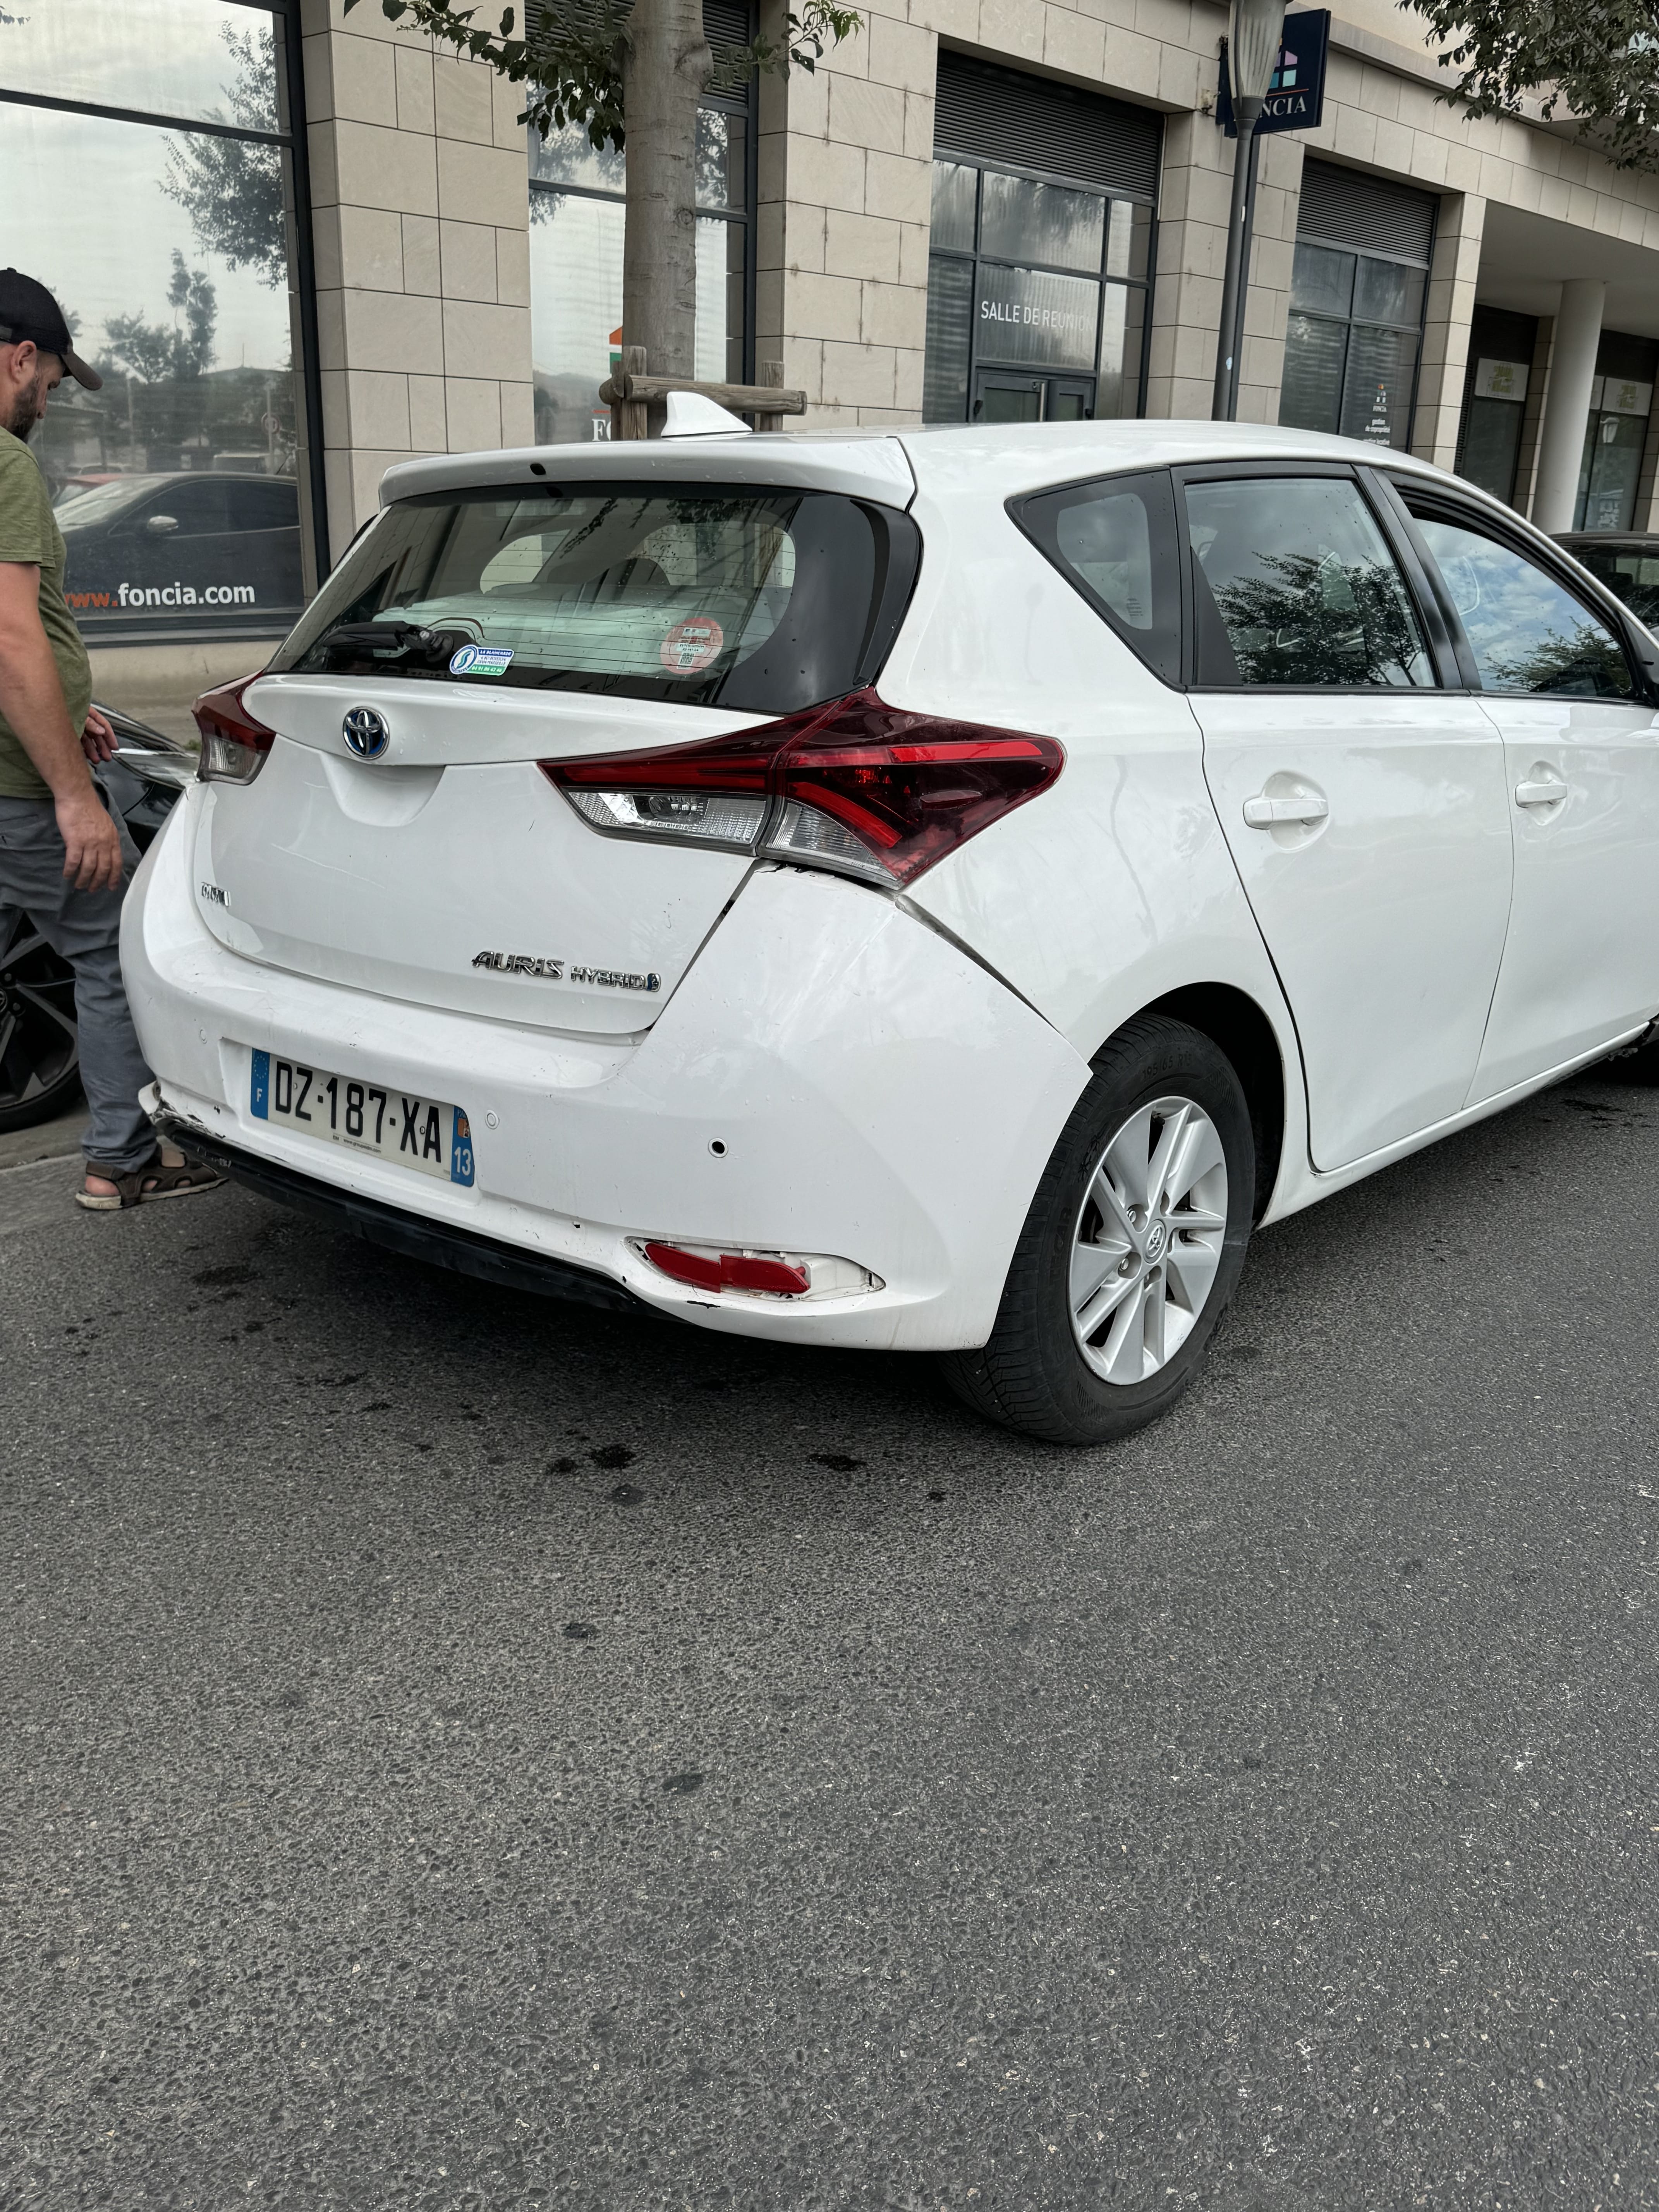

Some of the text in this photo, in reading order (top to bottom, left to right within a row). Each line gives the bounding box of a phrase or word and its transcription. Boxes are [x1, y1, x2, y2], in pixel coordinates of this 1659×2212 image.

[1259, 96, 1307, 118] NCIA
[981, 301, 1020, 323] SALLE
[1023, 306, 1039, 325] DE
[591, 419, 611, 441] F
[471, 950, 646, 991] AURIS HYBRID
[256, 1088, 263, 1103] F
[275, 1061, 441, 1163] DZ-187-XA
[454, 1146, 471, 1176] 13
